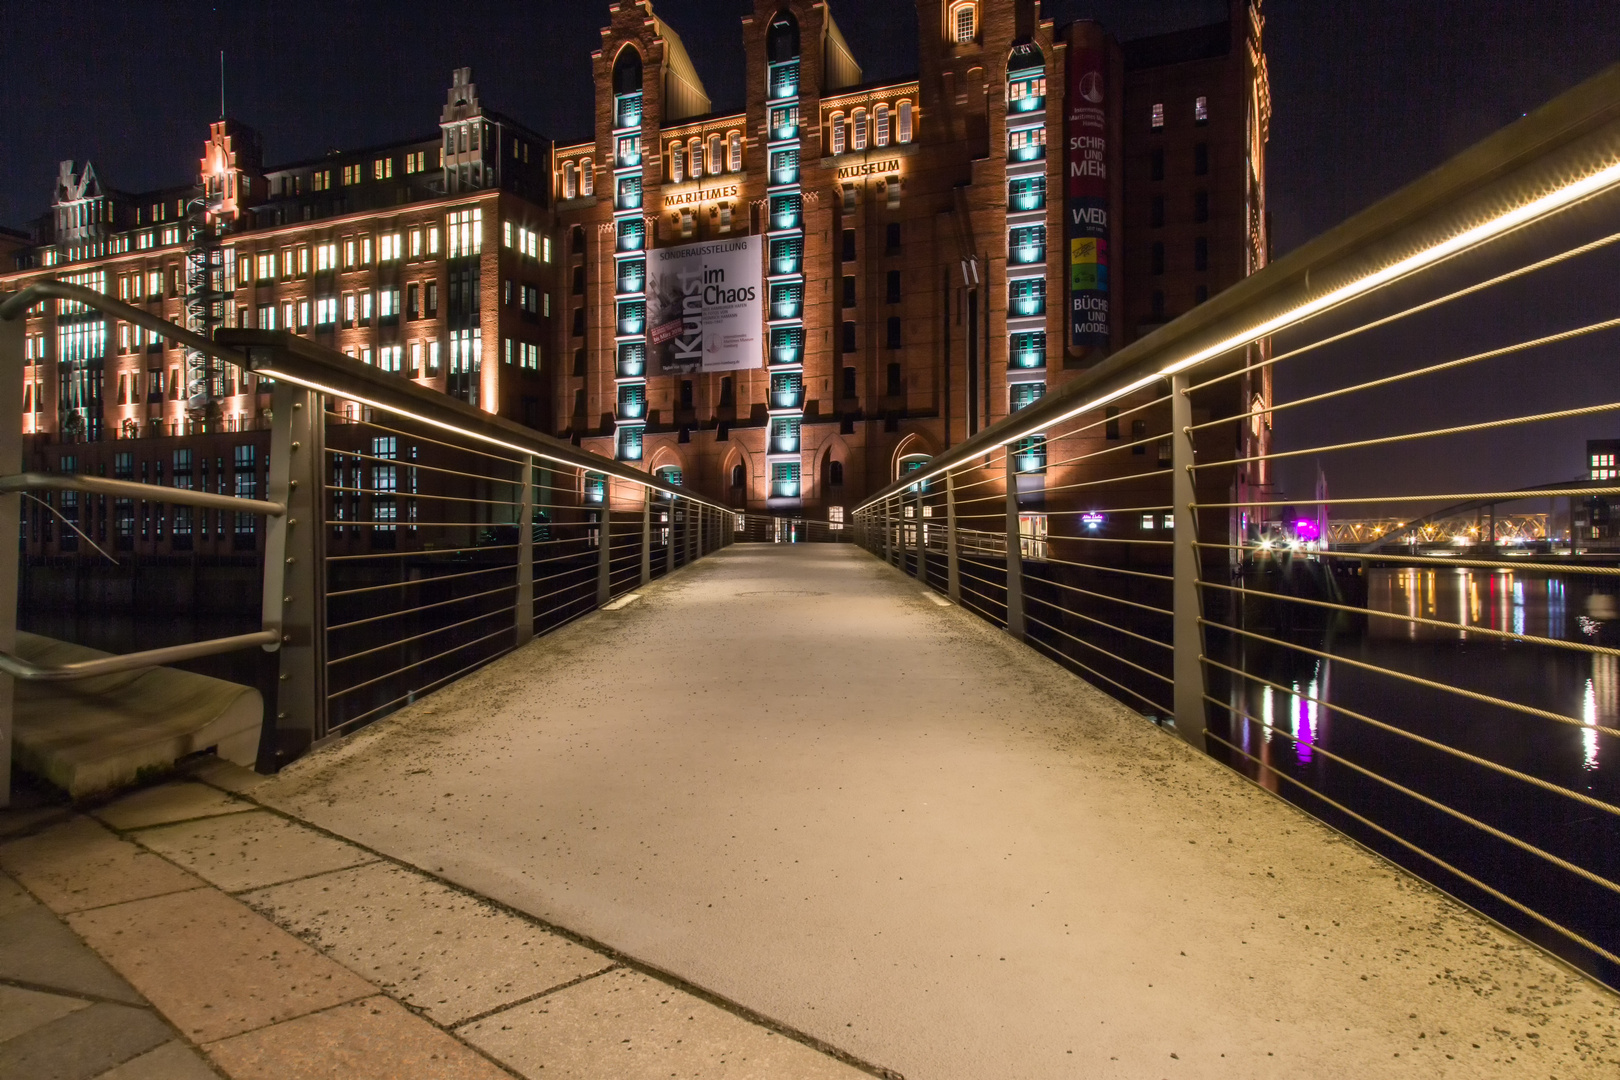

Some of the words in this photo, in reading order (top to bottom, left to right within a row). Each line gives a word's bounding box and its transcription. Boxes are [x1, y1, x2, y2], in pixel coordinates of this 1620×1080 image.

[1084, 150, 1103, 161] UND
[838, 159, 900, 179] MUSEUM
[665, 185, 737, 206] MARITIMES
[659, 241, 747, 261] SONDERAUSSTELLUNG
[704, 265, 725, 284] im
[703, 285, 756, 305] Chaos
[674, 266, 702, 360] Kunst
[1087, 311, 1106, 322] UND
